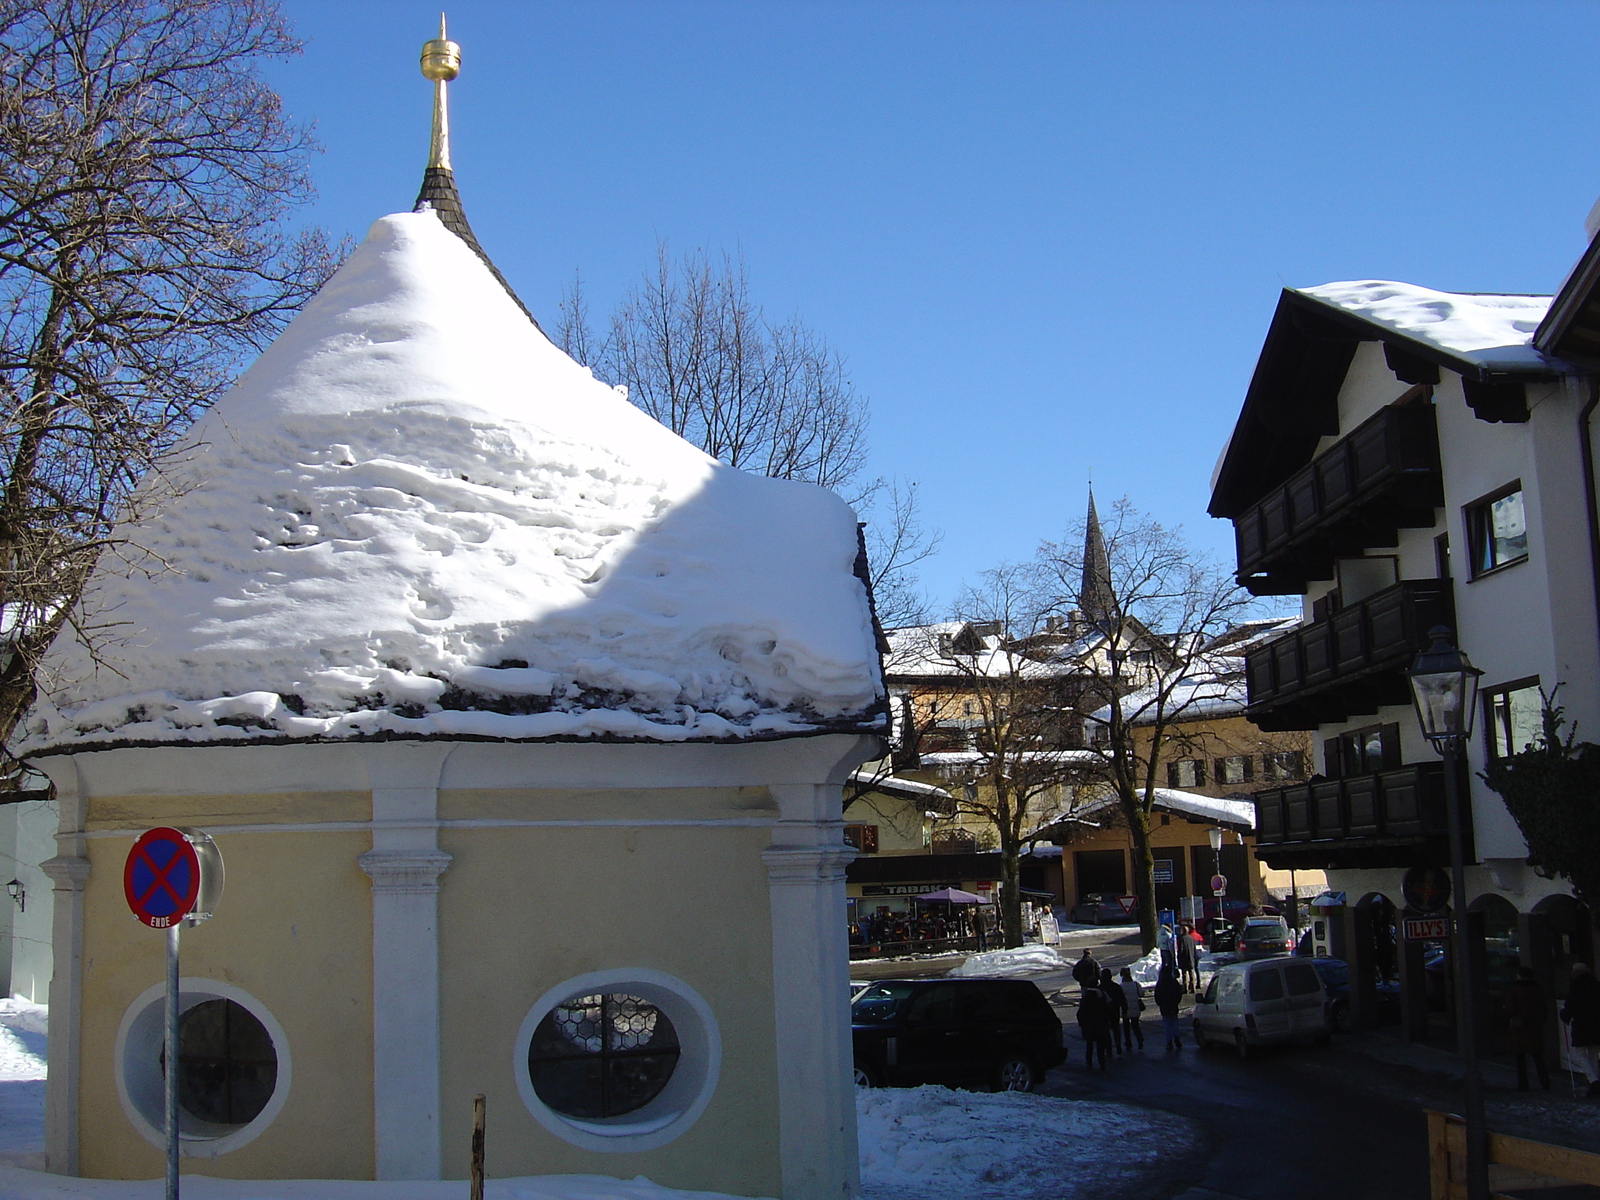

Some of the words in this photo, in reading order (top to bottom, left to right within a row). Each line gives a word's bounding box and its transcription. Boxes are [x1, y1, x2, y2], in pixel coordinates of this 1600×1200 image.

[886, 884, 943, 894] TABAK
[150, 916, 171, 927] ENDE
[1409, 920, 1443, 937] ILLY'S
